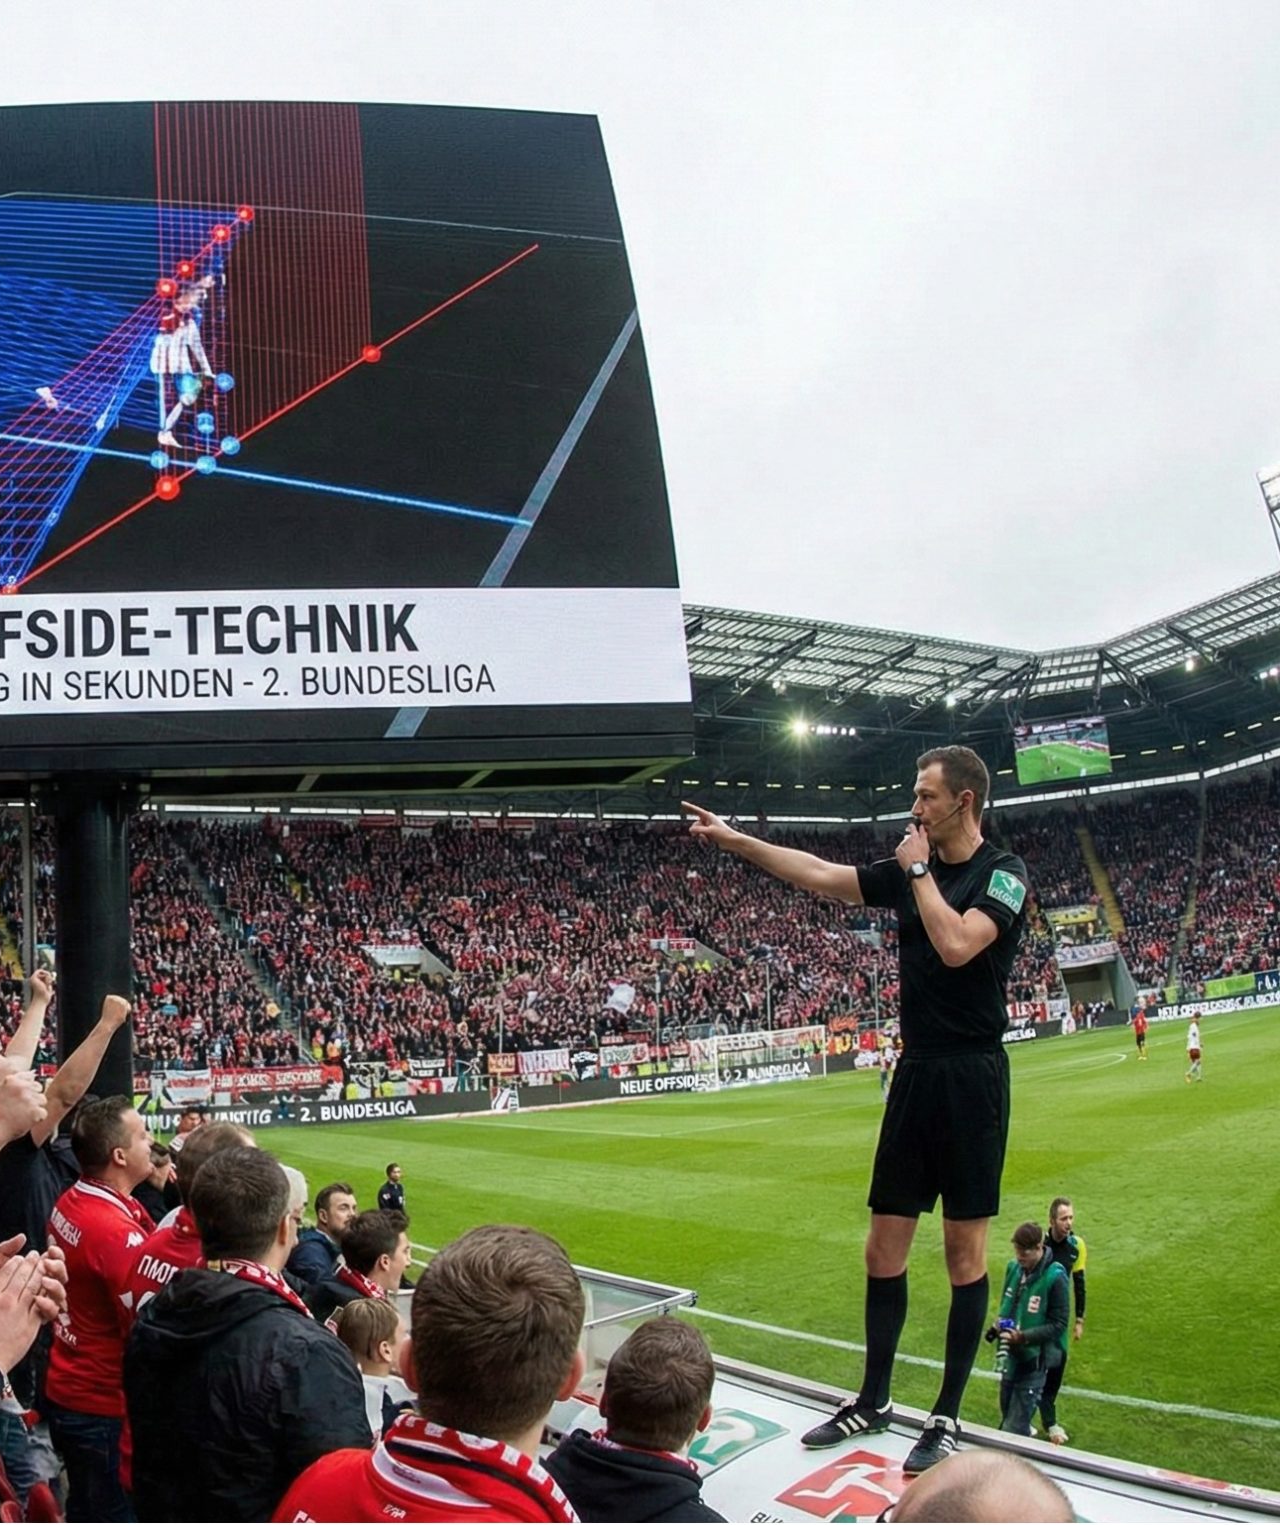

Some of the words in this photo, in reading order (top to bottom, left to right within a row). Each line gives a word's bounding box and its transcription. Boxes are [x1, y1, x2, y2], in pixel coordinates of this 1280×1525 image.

[22, 672, 52, 701] IN
[63, 668, 233, 701] SEKUNDEN
[262, 667, 296, 696] 2.
[301, 663, 496, 696] BUNDESLIGA
[620, 1078, 654, 1095] NEUE
[300, 1107, 317, 1122] 2.
[320, 1100, 417, 1121] BUNDESLIGA
